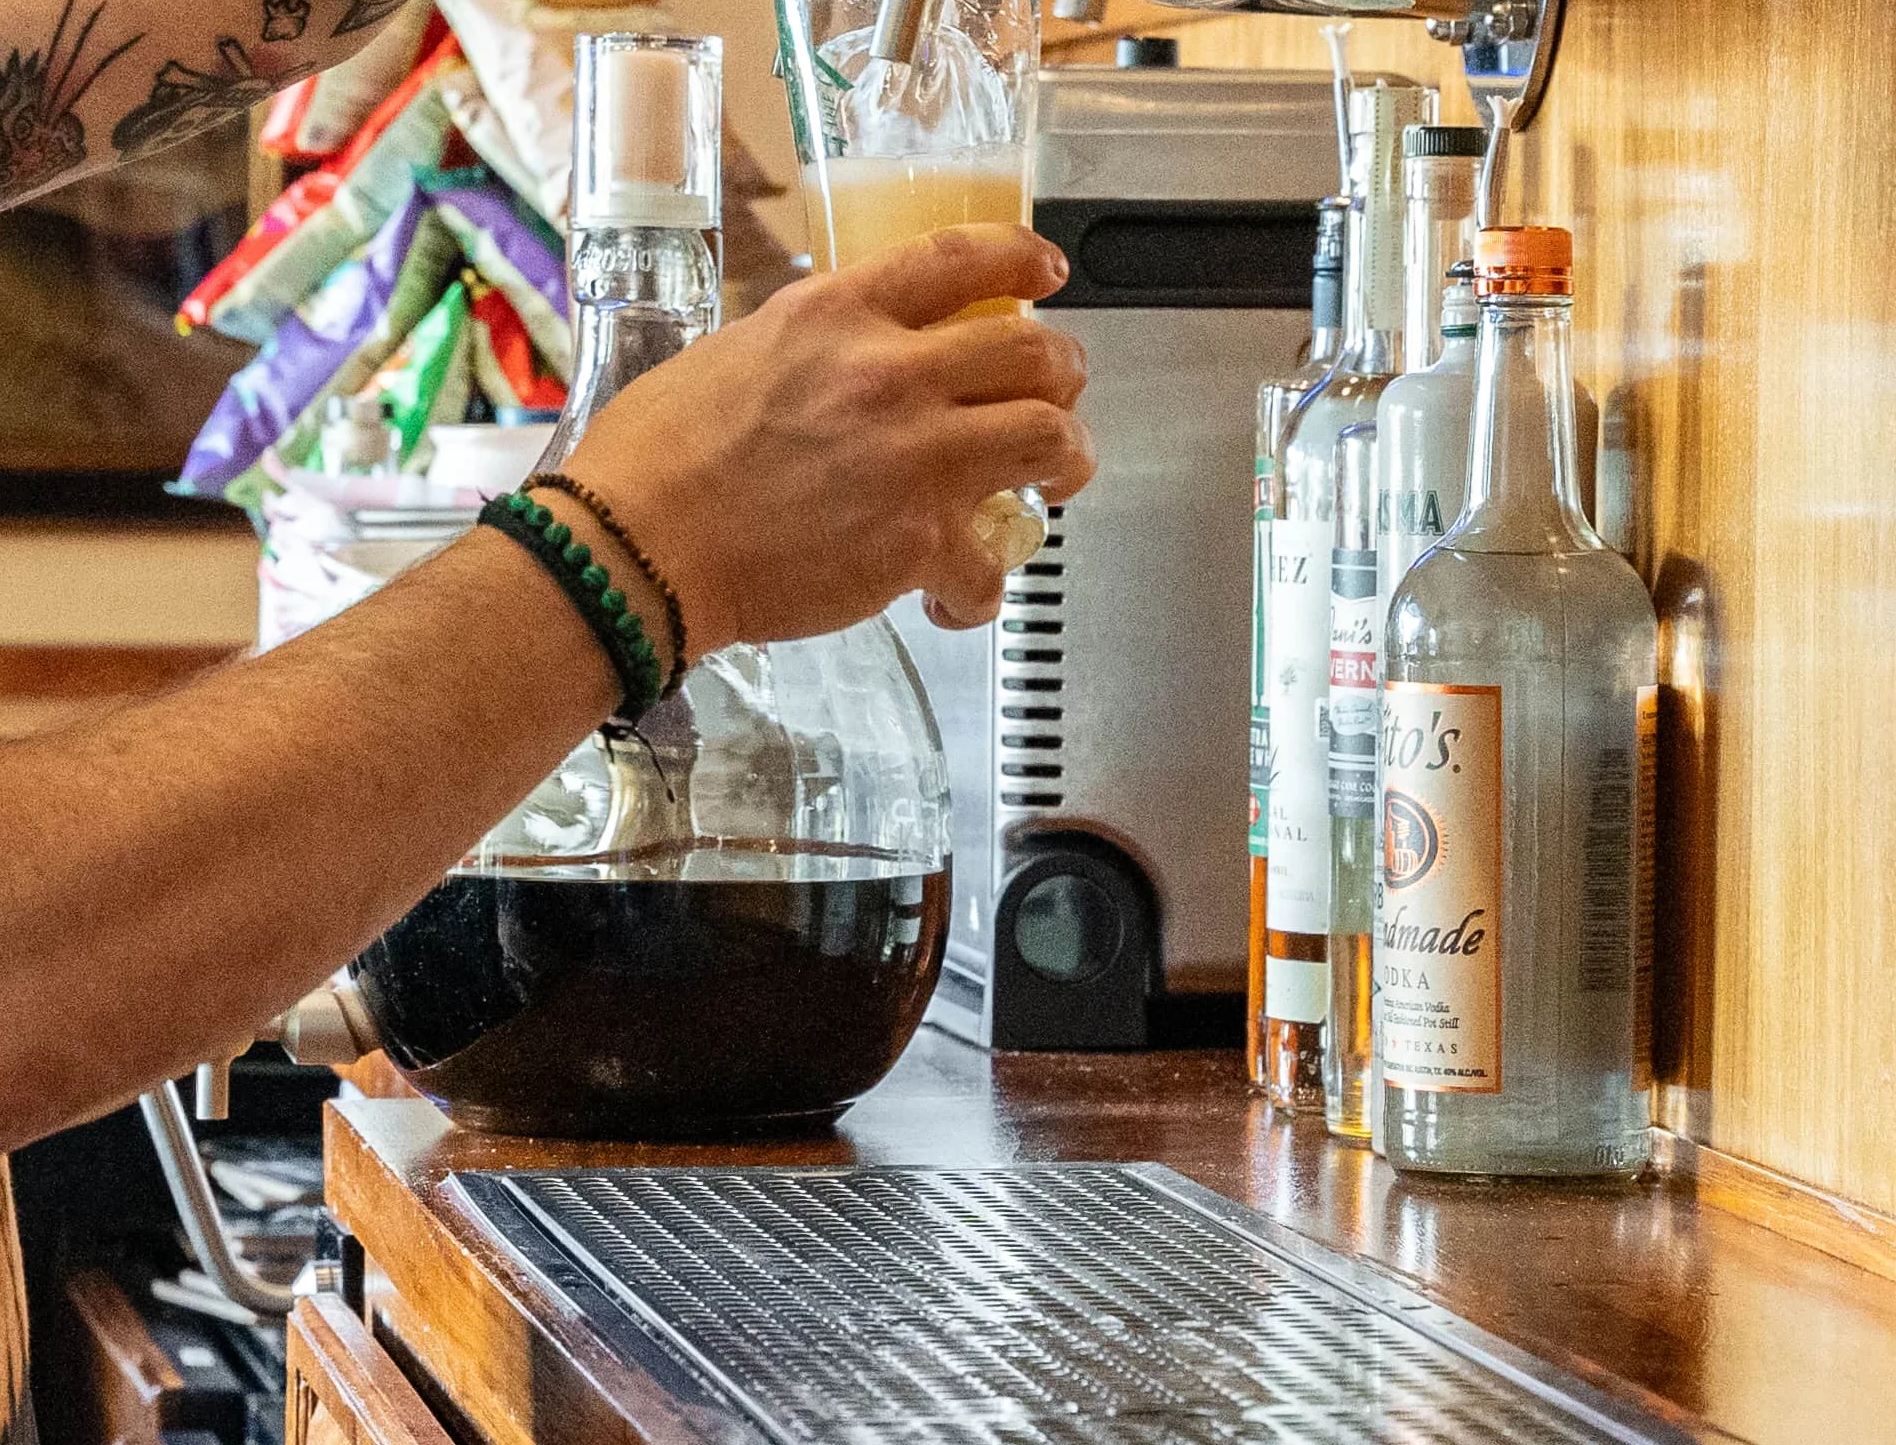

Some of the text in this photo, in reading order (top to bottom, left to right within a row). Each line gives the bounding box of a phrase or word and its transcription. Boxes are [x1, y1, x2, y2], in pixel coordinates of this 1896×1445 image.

[1424, 1001, 1450, 1013] Vodka
[1423, 1016, 1437, 1029] Pot
[1438, 1017, 1460, 1029] Still
[1404, 1038, 1459, 1055] TEXAS
